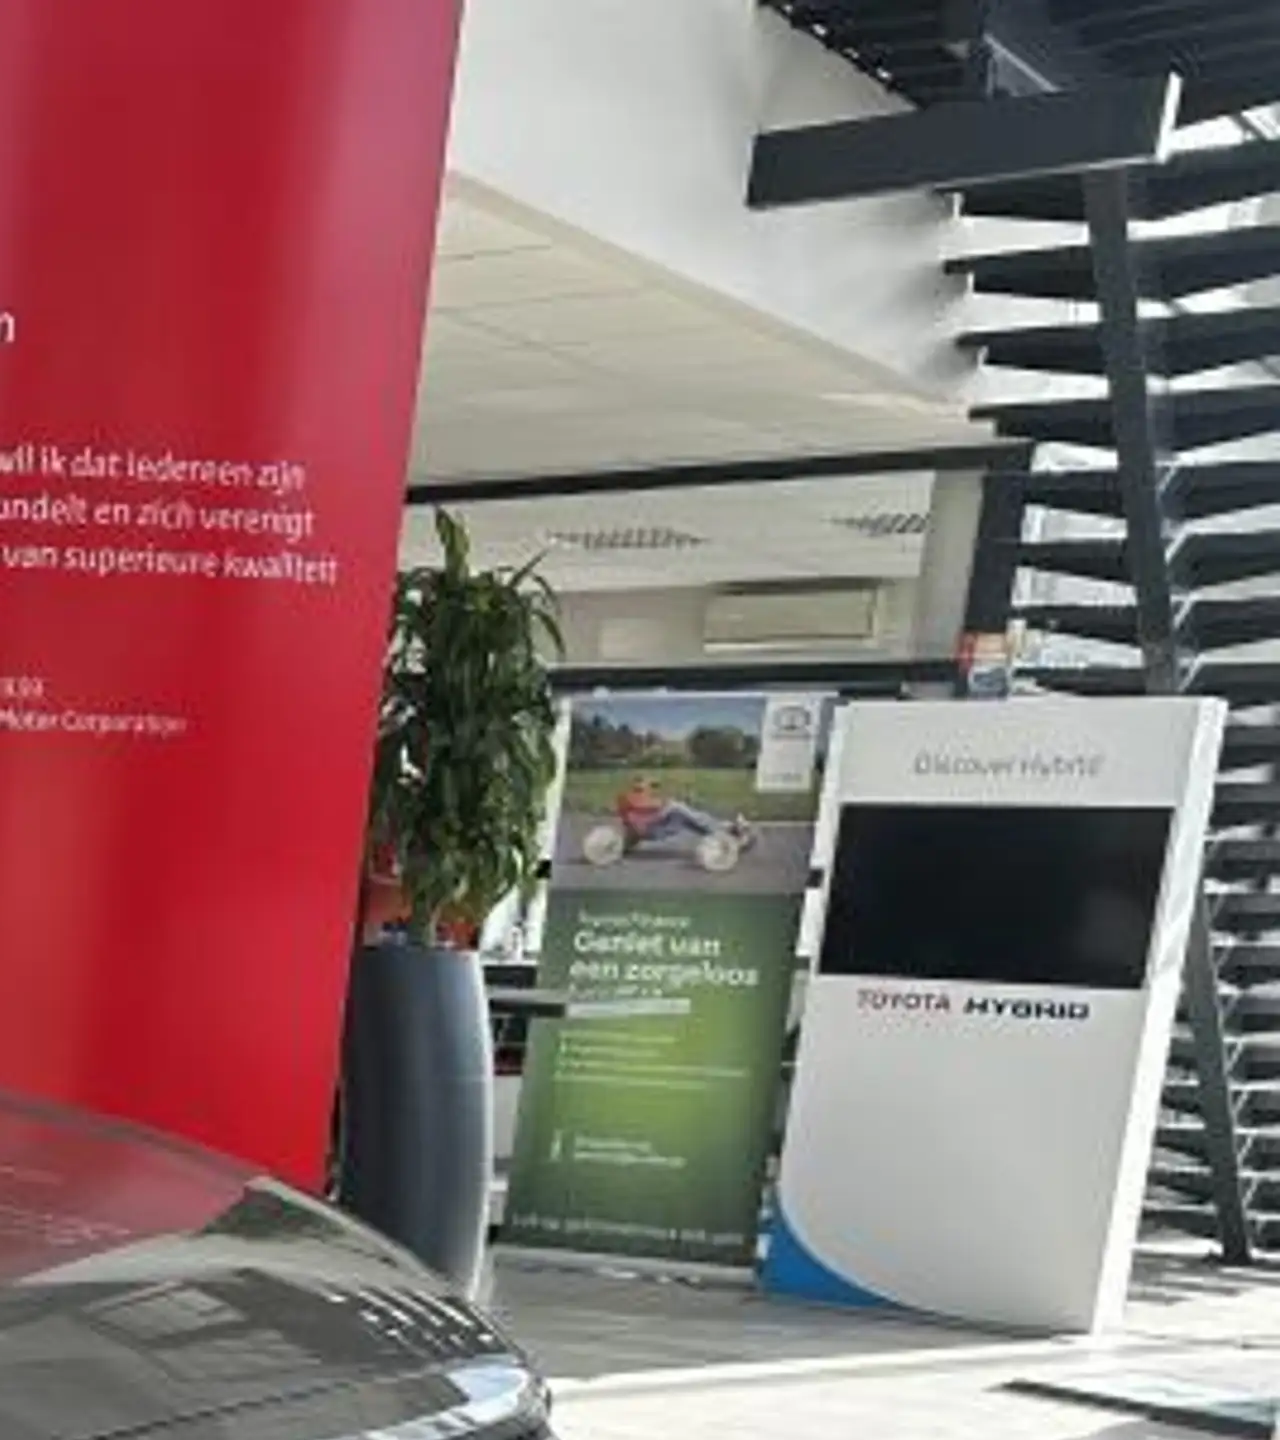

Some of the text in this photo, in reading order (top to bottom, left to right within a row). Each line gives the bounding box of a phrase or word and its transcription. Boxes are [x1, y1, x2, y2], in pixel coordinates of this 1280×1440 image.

[40, 445, 67, 475] ik
[70, 446, 123, 478] dat
[127, 449, 254, 486] iedereen
[257, 460, 307, 496] zijn
[93, 501, 131, 525] en
[135, 499, 193, 531] zich
[198, 504, 314, 545] verenigt
[1, 546, 59, 569] van
[63, 544, 220, 579] superieure
[222, 549, 339, 586] kwaliteit
[856, 987, 1090, 1021] TOYOTA HYBRID
